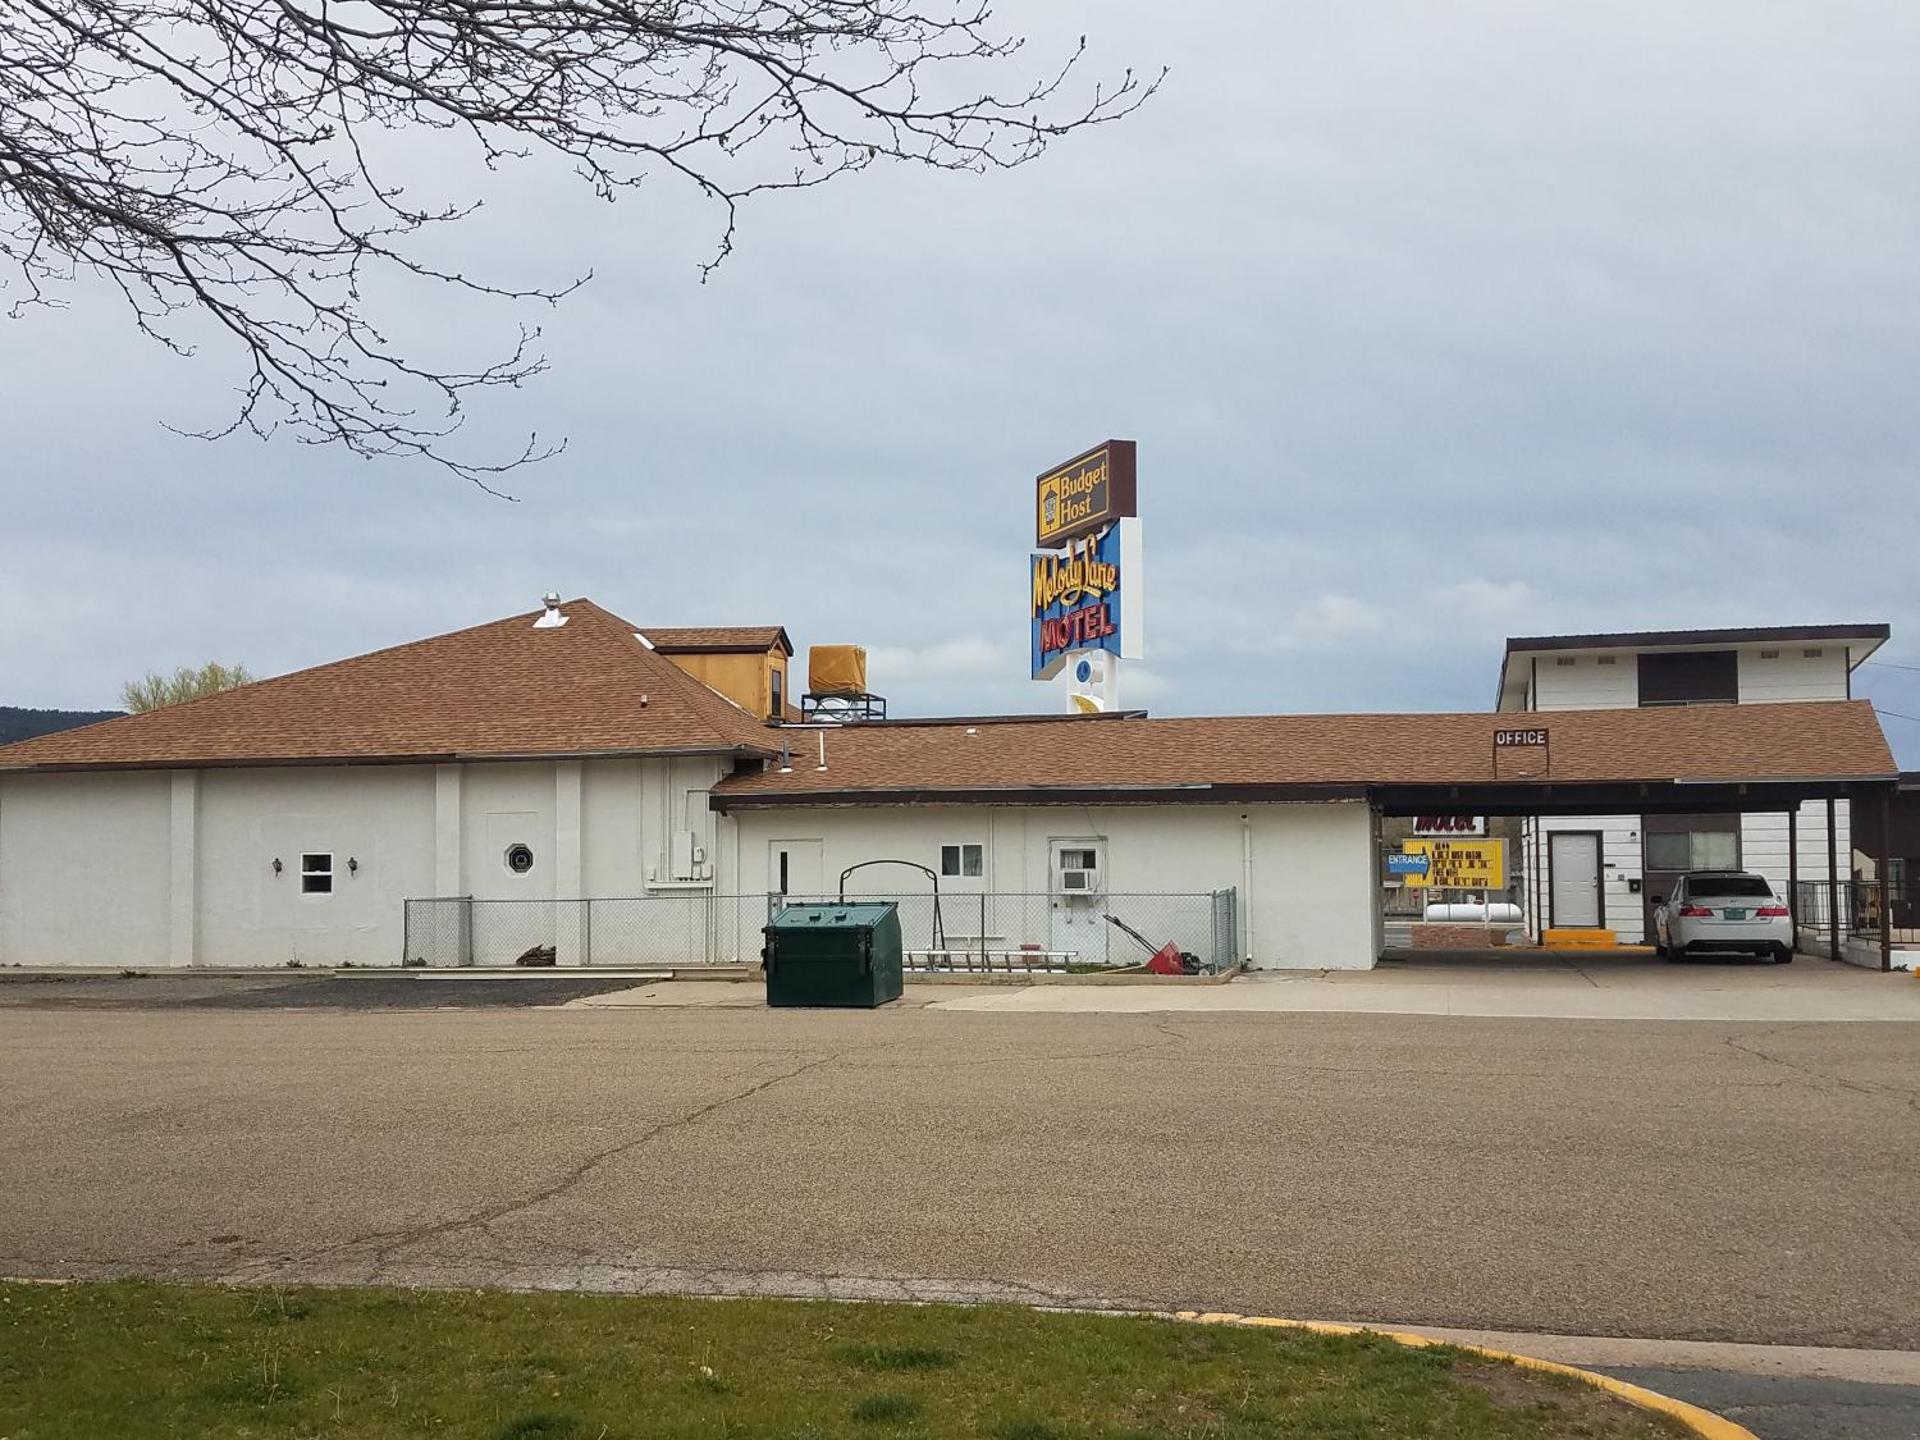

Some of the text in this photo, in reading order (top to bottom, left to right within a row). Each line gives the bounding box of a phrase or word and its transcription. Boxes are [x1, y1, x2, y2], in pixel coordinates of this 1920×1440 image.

[1060, 460, 1106, 500] Budget
[1060, 494, 1092, 525] Host
[1032, 533, 1117, 617] Melody Lane
[1040, 603, 1116, 653] MOTEL
[1496, 731, 1546, 744] OFFICE
[1388, 854, 1428, 865] ENTRANCE
